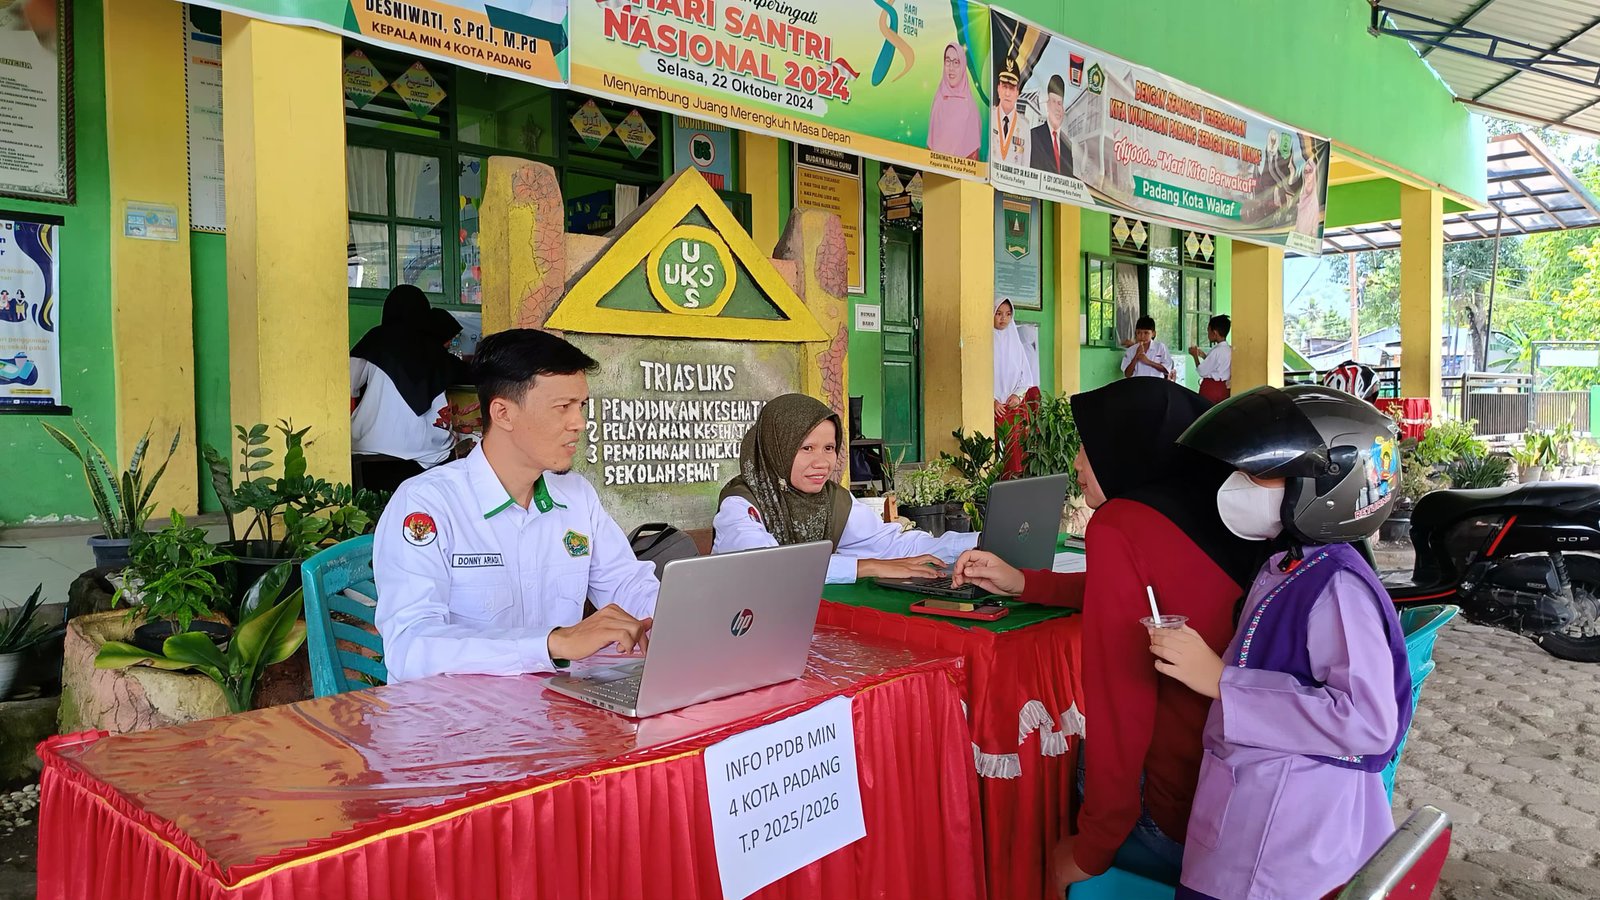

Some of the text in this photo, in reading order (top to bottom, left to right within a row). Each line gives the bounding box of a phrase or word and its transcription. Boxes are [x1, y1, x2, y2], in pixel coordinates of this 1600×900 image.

[365, 0, 537, 54] DESNIWATI, S.Pd.I, M.Pd
[742, 0, 818, 24] peringati
[372, 21, 532, 70] KEPALA MIN 4 KOTA PADANG
[631, 0, 832, 62] ARI SANTRI
[603, 7, 850, 101] NASIONAL 2024
[657, 58, 814, 110] Selasa, 22 Oktober 2024
[1135, 80, 1167, 110] DENGAN
[603, 74, 851, 144] Menyambung Juang Merengkuh Masa Depan
[1110, 98, 1126, 122] KITA
[1128, 104, 1169, 136] WUJUDKAN
[1169, 119, 1198, 146] PADANG
[1186, 159, 1207, 181] Kita
[1142, 180, 1235, 216] Padang Kota Wakaf
[664, 264, 715, 288] UKS
[640, 360, 736, 392] TRIAS UKS
[588, 398, 767, 422] 1 PENDIDIKAN KESEHAT
[586, 422, 600, 442] 2
[603, 422, 690, 441] PELAYANAN
[586, 444, 598, 464] 3
[604, 443, 690, 462] PEMBINAAN
[604, 463, 720, 486] SEKOLAH SEHAT
[458, 556, 481, 565] DONNY
[732, 609, 752, 637] hp
[726, 723, 836, 782] INFO PPDB MIN
[729, 756, 840, 817] 4 KOTA PADANG
[739, 792, 839, 853] T.P 2025/2026
